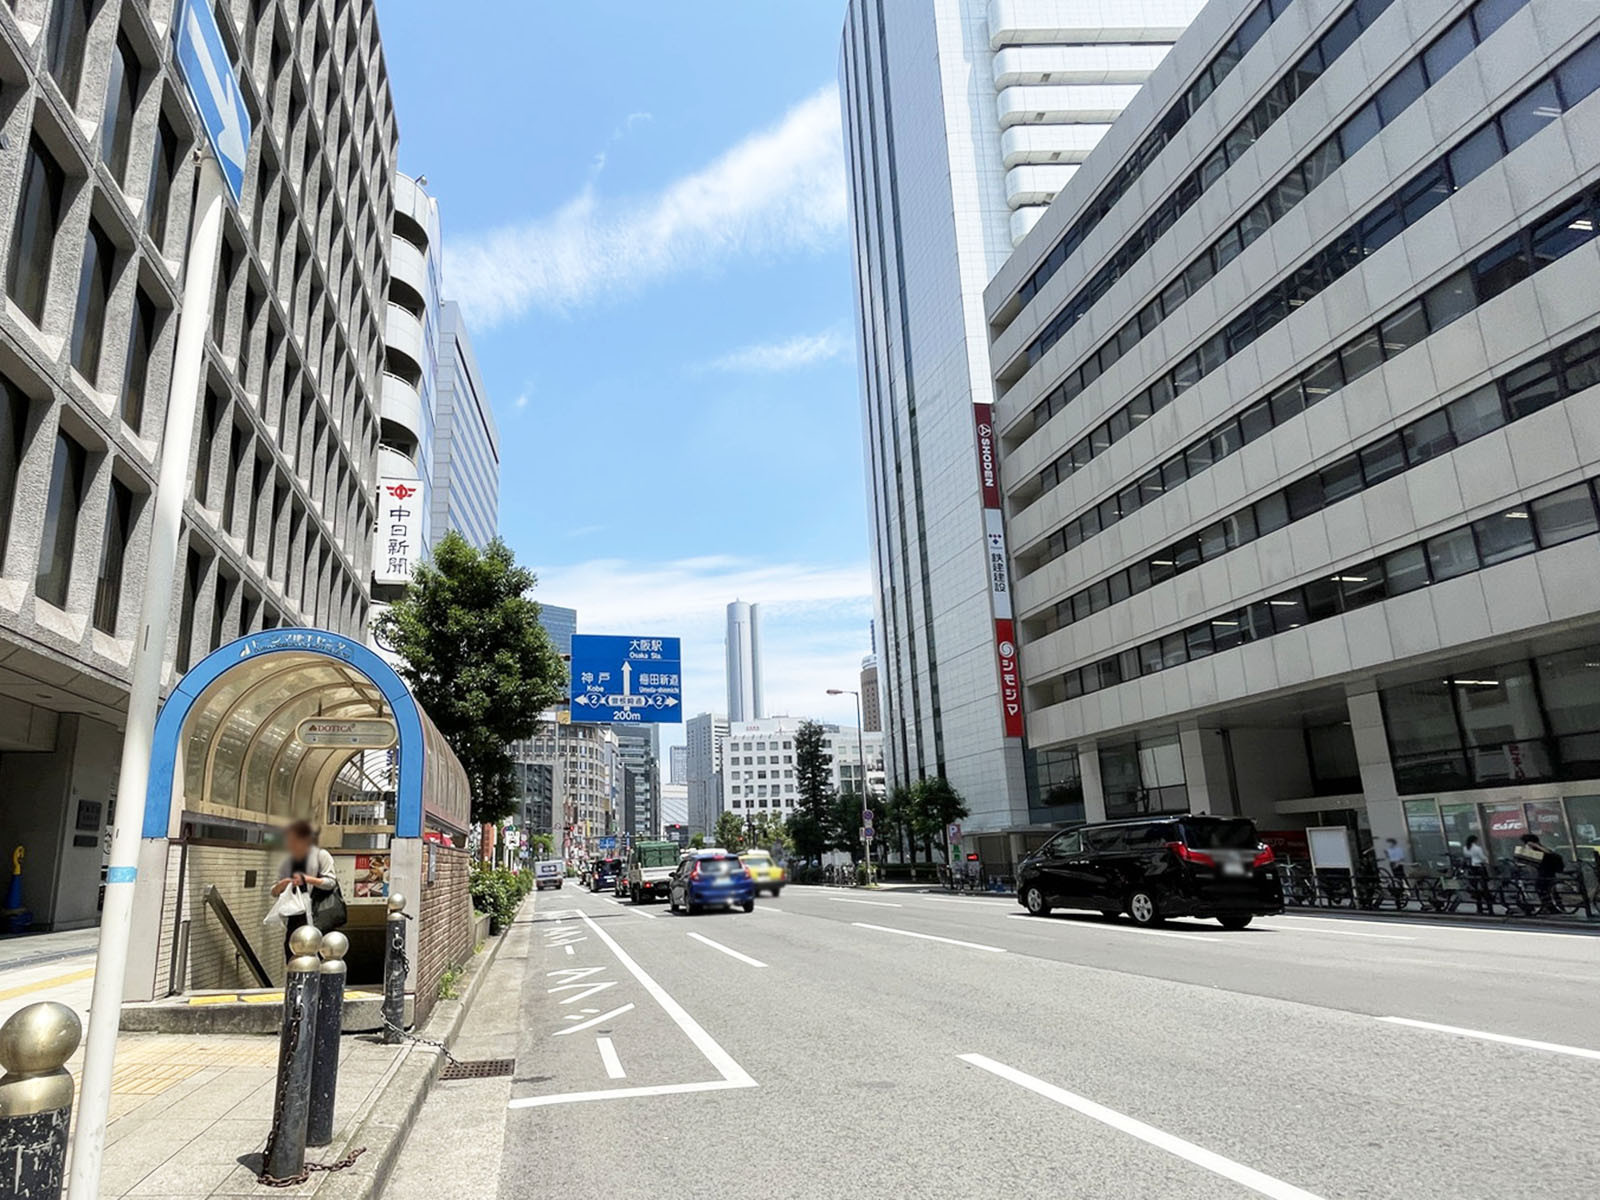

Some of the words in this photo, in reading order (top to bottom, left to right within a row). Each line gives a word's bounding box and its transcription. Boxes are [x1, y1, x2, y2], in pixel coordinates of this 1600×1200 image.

[981, 438, 994, 487] SHODEN
[386, 505, 411, 575] 中日新聞
[991, 553, 1006, 592] 鉄建建設
[629, 639, 663, 652] 大阪駅
[580, 671, 611, 684] 神戸
[586, 684, 604, 693] Kobe
[1001, 660, 1018, 717] シモジマ
[591, 695, 597, 704] 2
[656, 696, 662, 705] 2
[613, 710, 641, 721] 200m
[546, 966, 636, 1080] タクシー
